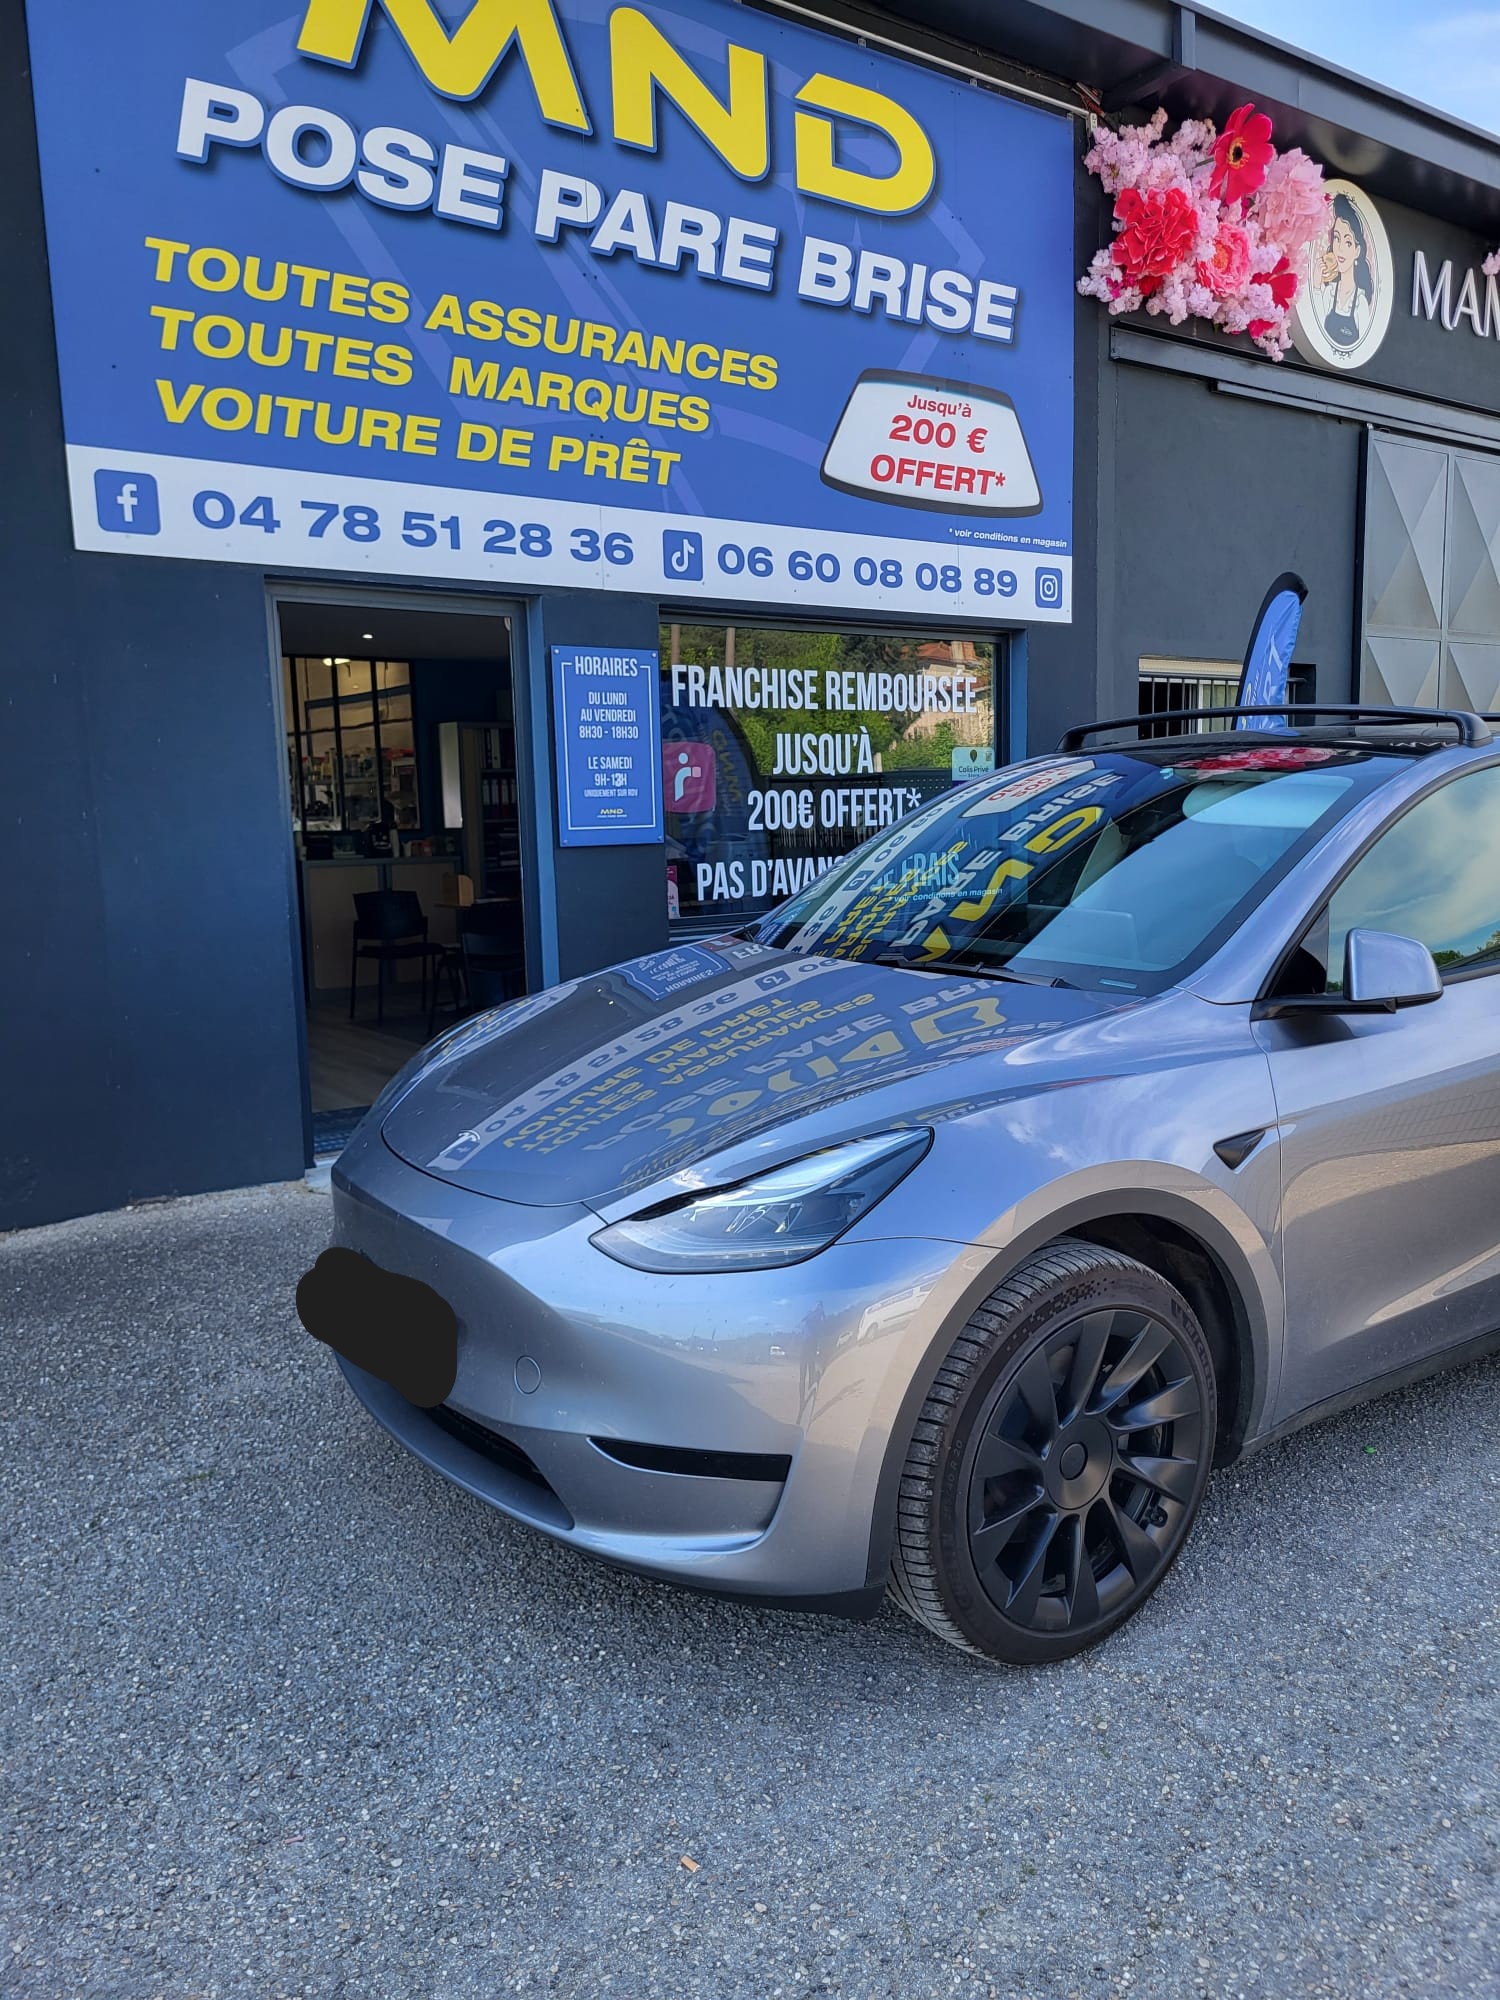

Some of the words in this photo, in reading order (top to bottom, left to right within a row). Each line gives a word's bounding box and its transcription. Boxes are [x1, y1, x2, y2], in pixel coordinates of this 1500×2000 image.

[298, 0, 934, 211] MND
[176, 78, 506, 224] POSE
[535, 169, 777, 287] PARE
[798, 236, 1017, 340] BRISE
[146, 237, 409, 323] TOUTES
[426, 295, 777, 389] ASSURANCES
[151, 306, 412, 385] TOUTES
[450, 357, 709, 431] MARQUES
[907, 395, 972, 418] Jusqu'à
[157, 380, 440, 455] VOITURE
[458, 424, 533, 467] DE
[549, 436, 680, 484] PRÊT
[889, 415, 956, 449] 200
[966, 428, 988, 454] €
[192, 491, 281, 534] 04
[300, 500, 381, 543] 78
[401, 511, 461, 550] 51
[483, 519, 553, 558] 28
[570, 528, 634, 566] 36
[955, 528, 971, 538] voir
[974, 531, 1018, 543] conditions
[1020, 536, 1031, 544] en
[1033, 538, 1067, 548] magasin
[717, 543, 774, 578] 06
[788, 550, 841, 583] 60
[853, 556, 903, 589] 08
[915, 562, 962, 593] 08
[973, 567, 1018, 598] 89
[574, 655, 638, 677] HORAIRES
[588, 692, 601, 705] DU
[602, 693, 627, 705] LUNDI
[671, 665, 819, 710] FRANCHISE
[825, 670, 978, 713] REMBOURSÉE
[579, 726, 603, 739] 8H30
[611, 726, 639, 739] 18H30
[580, 709, 592, 722] AU
[594, 709, 636, 722] VENDREDI
[588, 756, 599, 769] LE
[600, 756, 633, 769] SAMEDI
[772, 726, 874, 776] JUSQU'À
[748, 790, 814, 831] 200€
[697, 862, 745, 901] PAS
